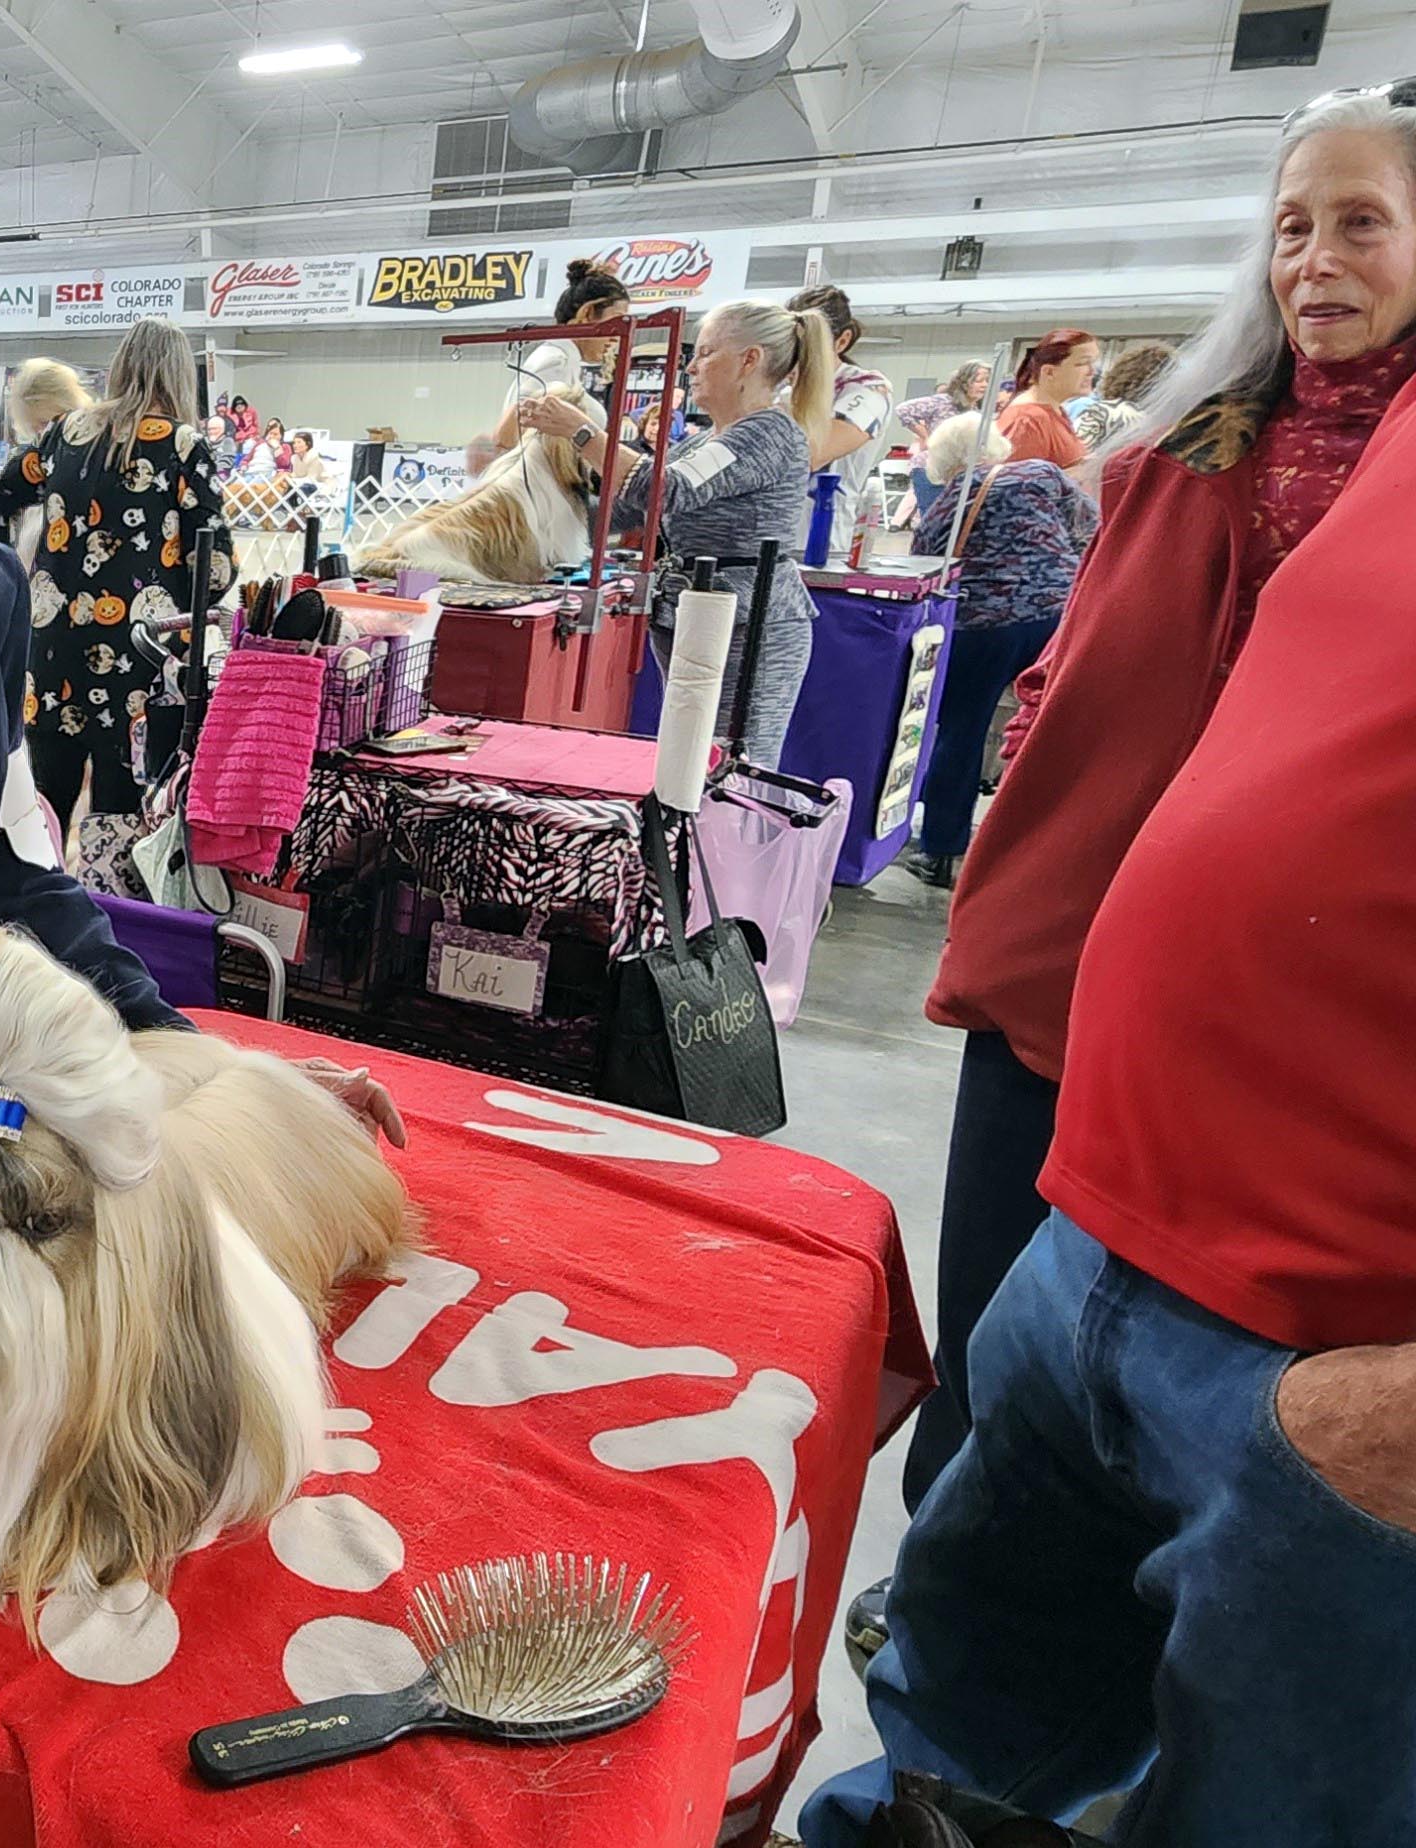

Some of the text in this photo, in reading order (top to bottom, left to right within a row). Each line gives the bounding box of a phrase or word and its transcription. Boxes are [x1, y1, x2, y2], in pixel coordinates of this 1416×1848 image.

[110, 278, 182, 293] COLORADO
[370, 253, 532, 303] BRADLEY
[56, 282, 104, 303] SCI
[210, 262, 301, 318] Glaser
[401, 287, 496, 304] EXCAVATING
[116, 294, 174, 308] CHAPTER
